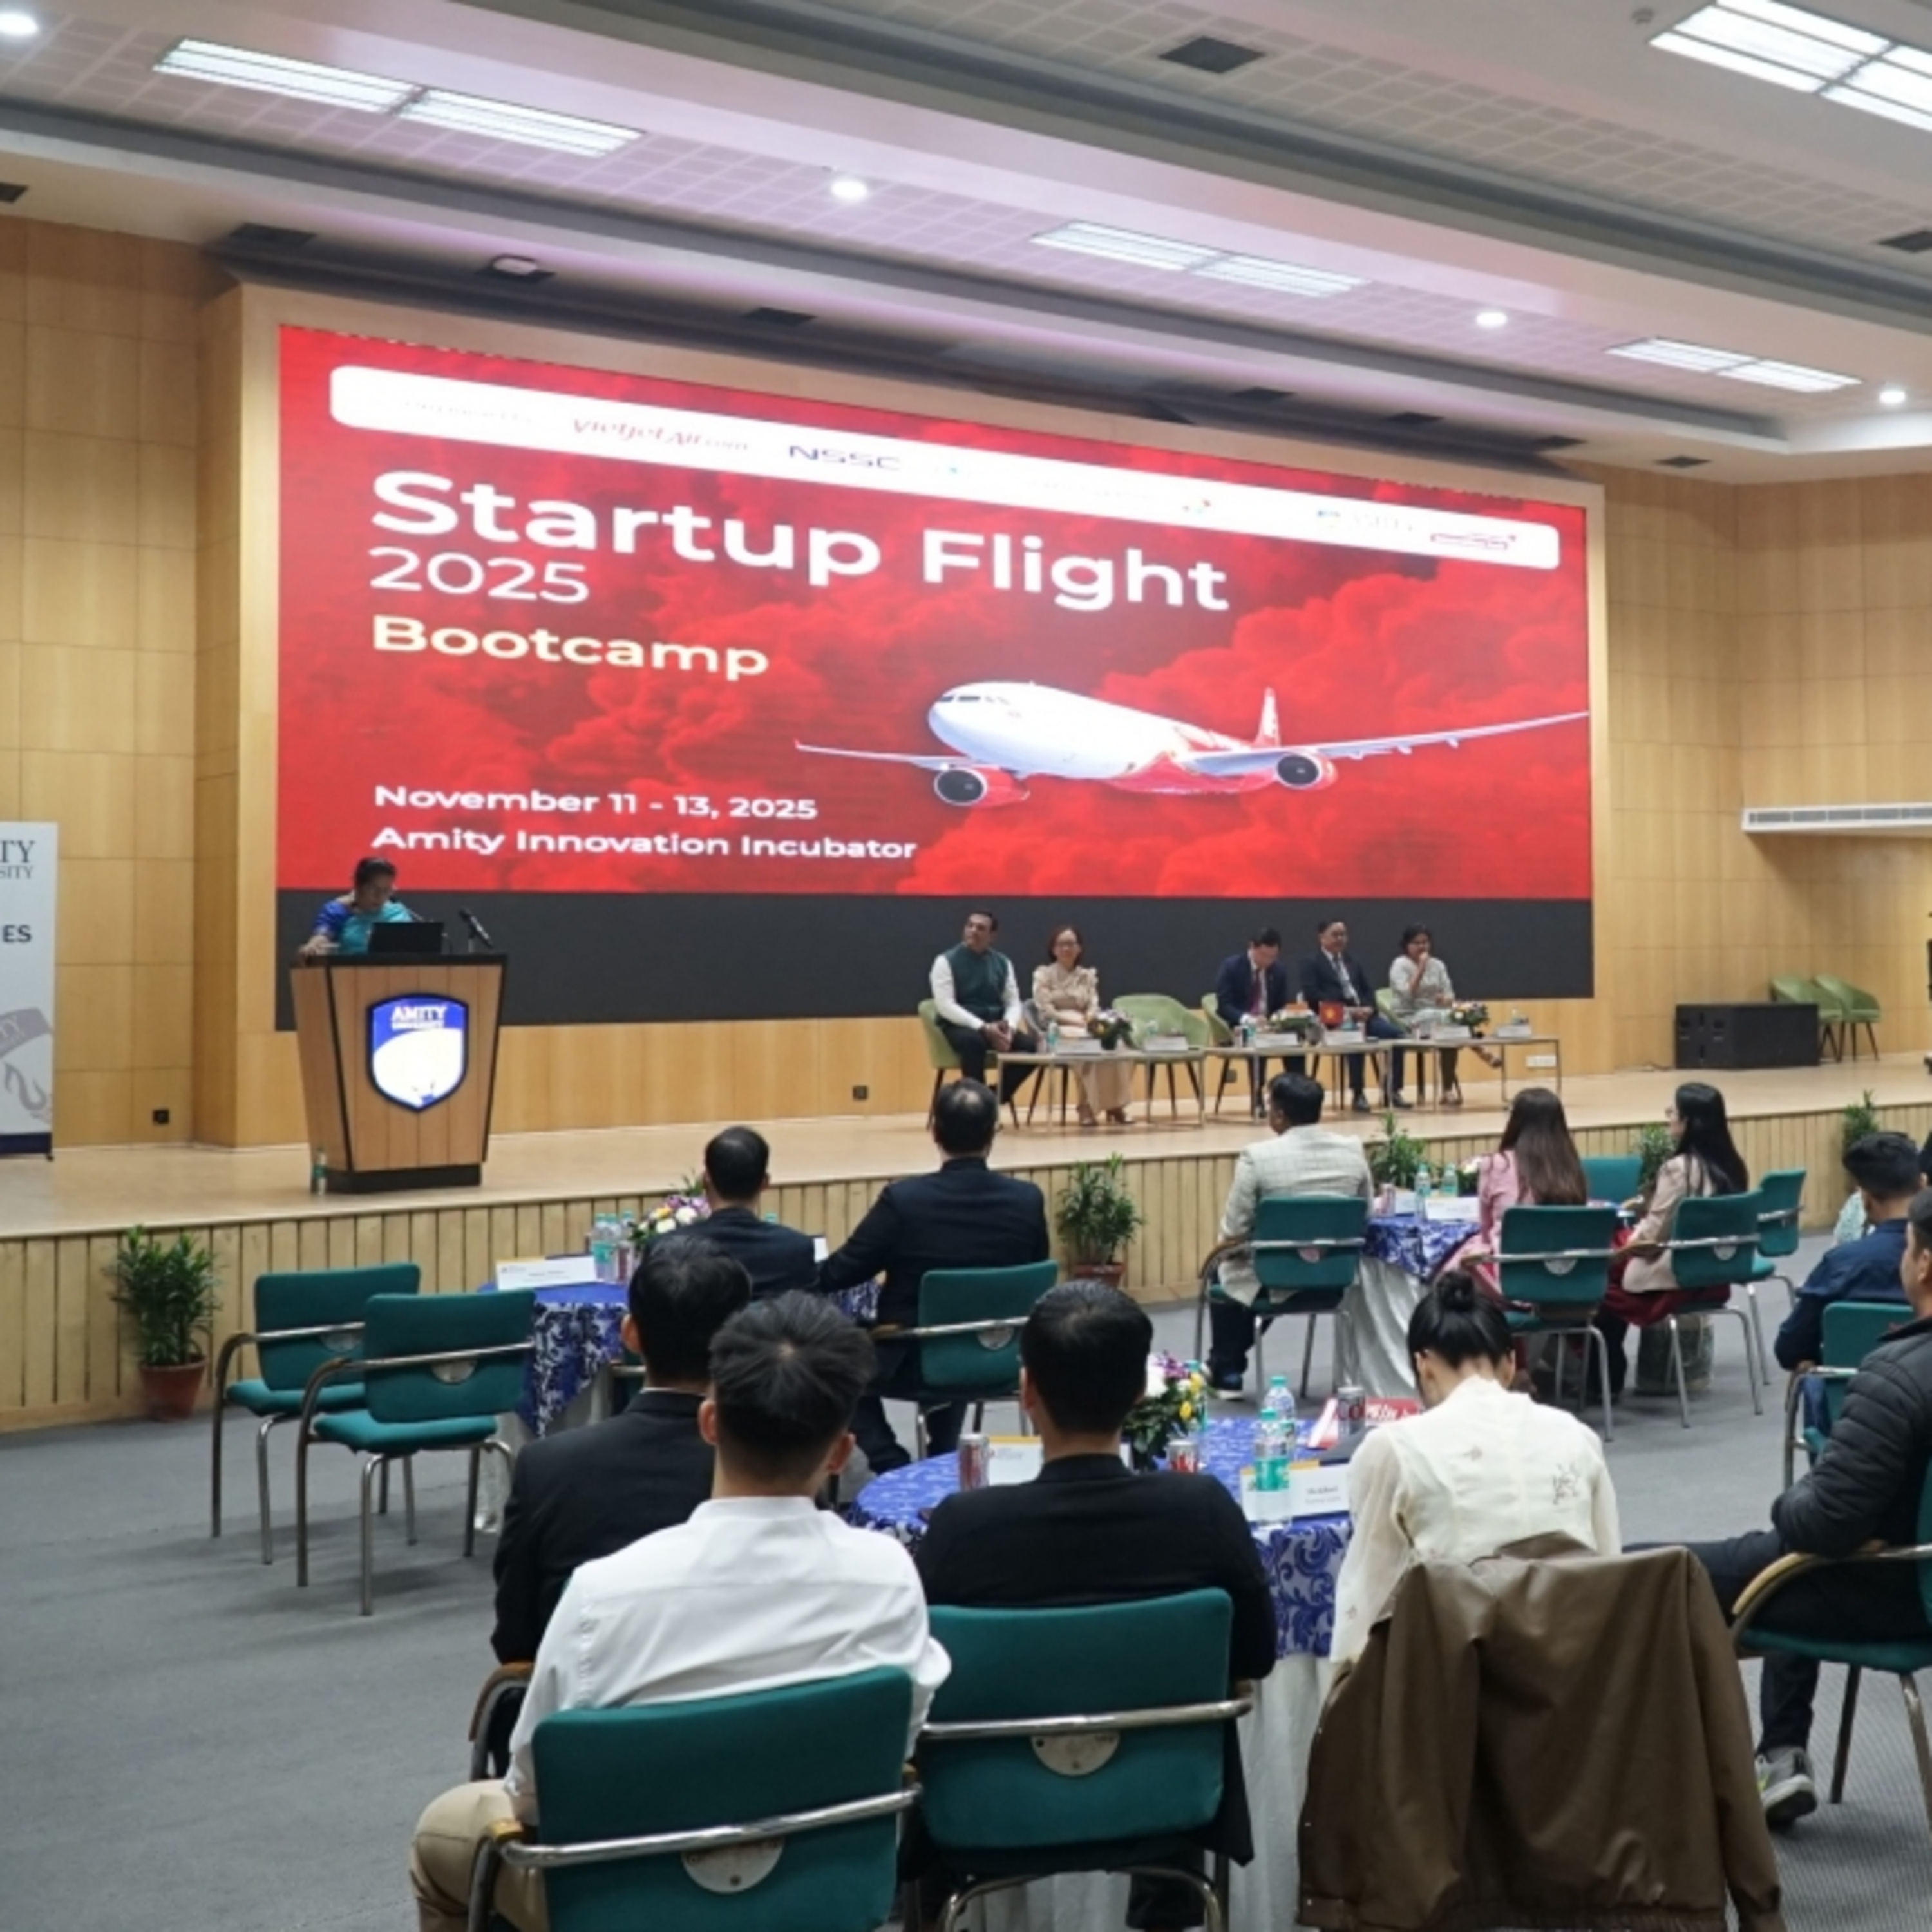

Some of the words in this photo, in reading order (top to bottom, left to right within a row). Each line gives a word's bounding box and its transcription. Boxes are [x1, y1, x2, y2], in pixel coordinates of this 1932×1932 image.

[789, 444, 900, 472] NSSC
[372, 470, 881, 587] Startup
[923, 528, 1230, 612] Flight
[368, 546, 589, 603] 2025
[374, 614, 768, 681] Bootcamp
[375, 786, 599, 811] November
[609, 793, 636, 813] 11
[674, 796, 719, 819] 13,
[730, 797, 817, 819] 2025
[372, 828, 505, 855] Amity
[517, 831, 728, 855] Innovation
[742, 836, 916, 858] Incubator
[392, 1005, 448, 1021] AMITY
